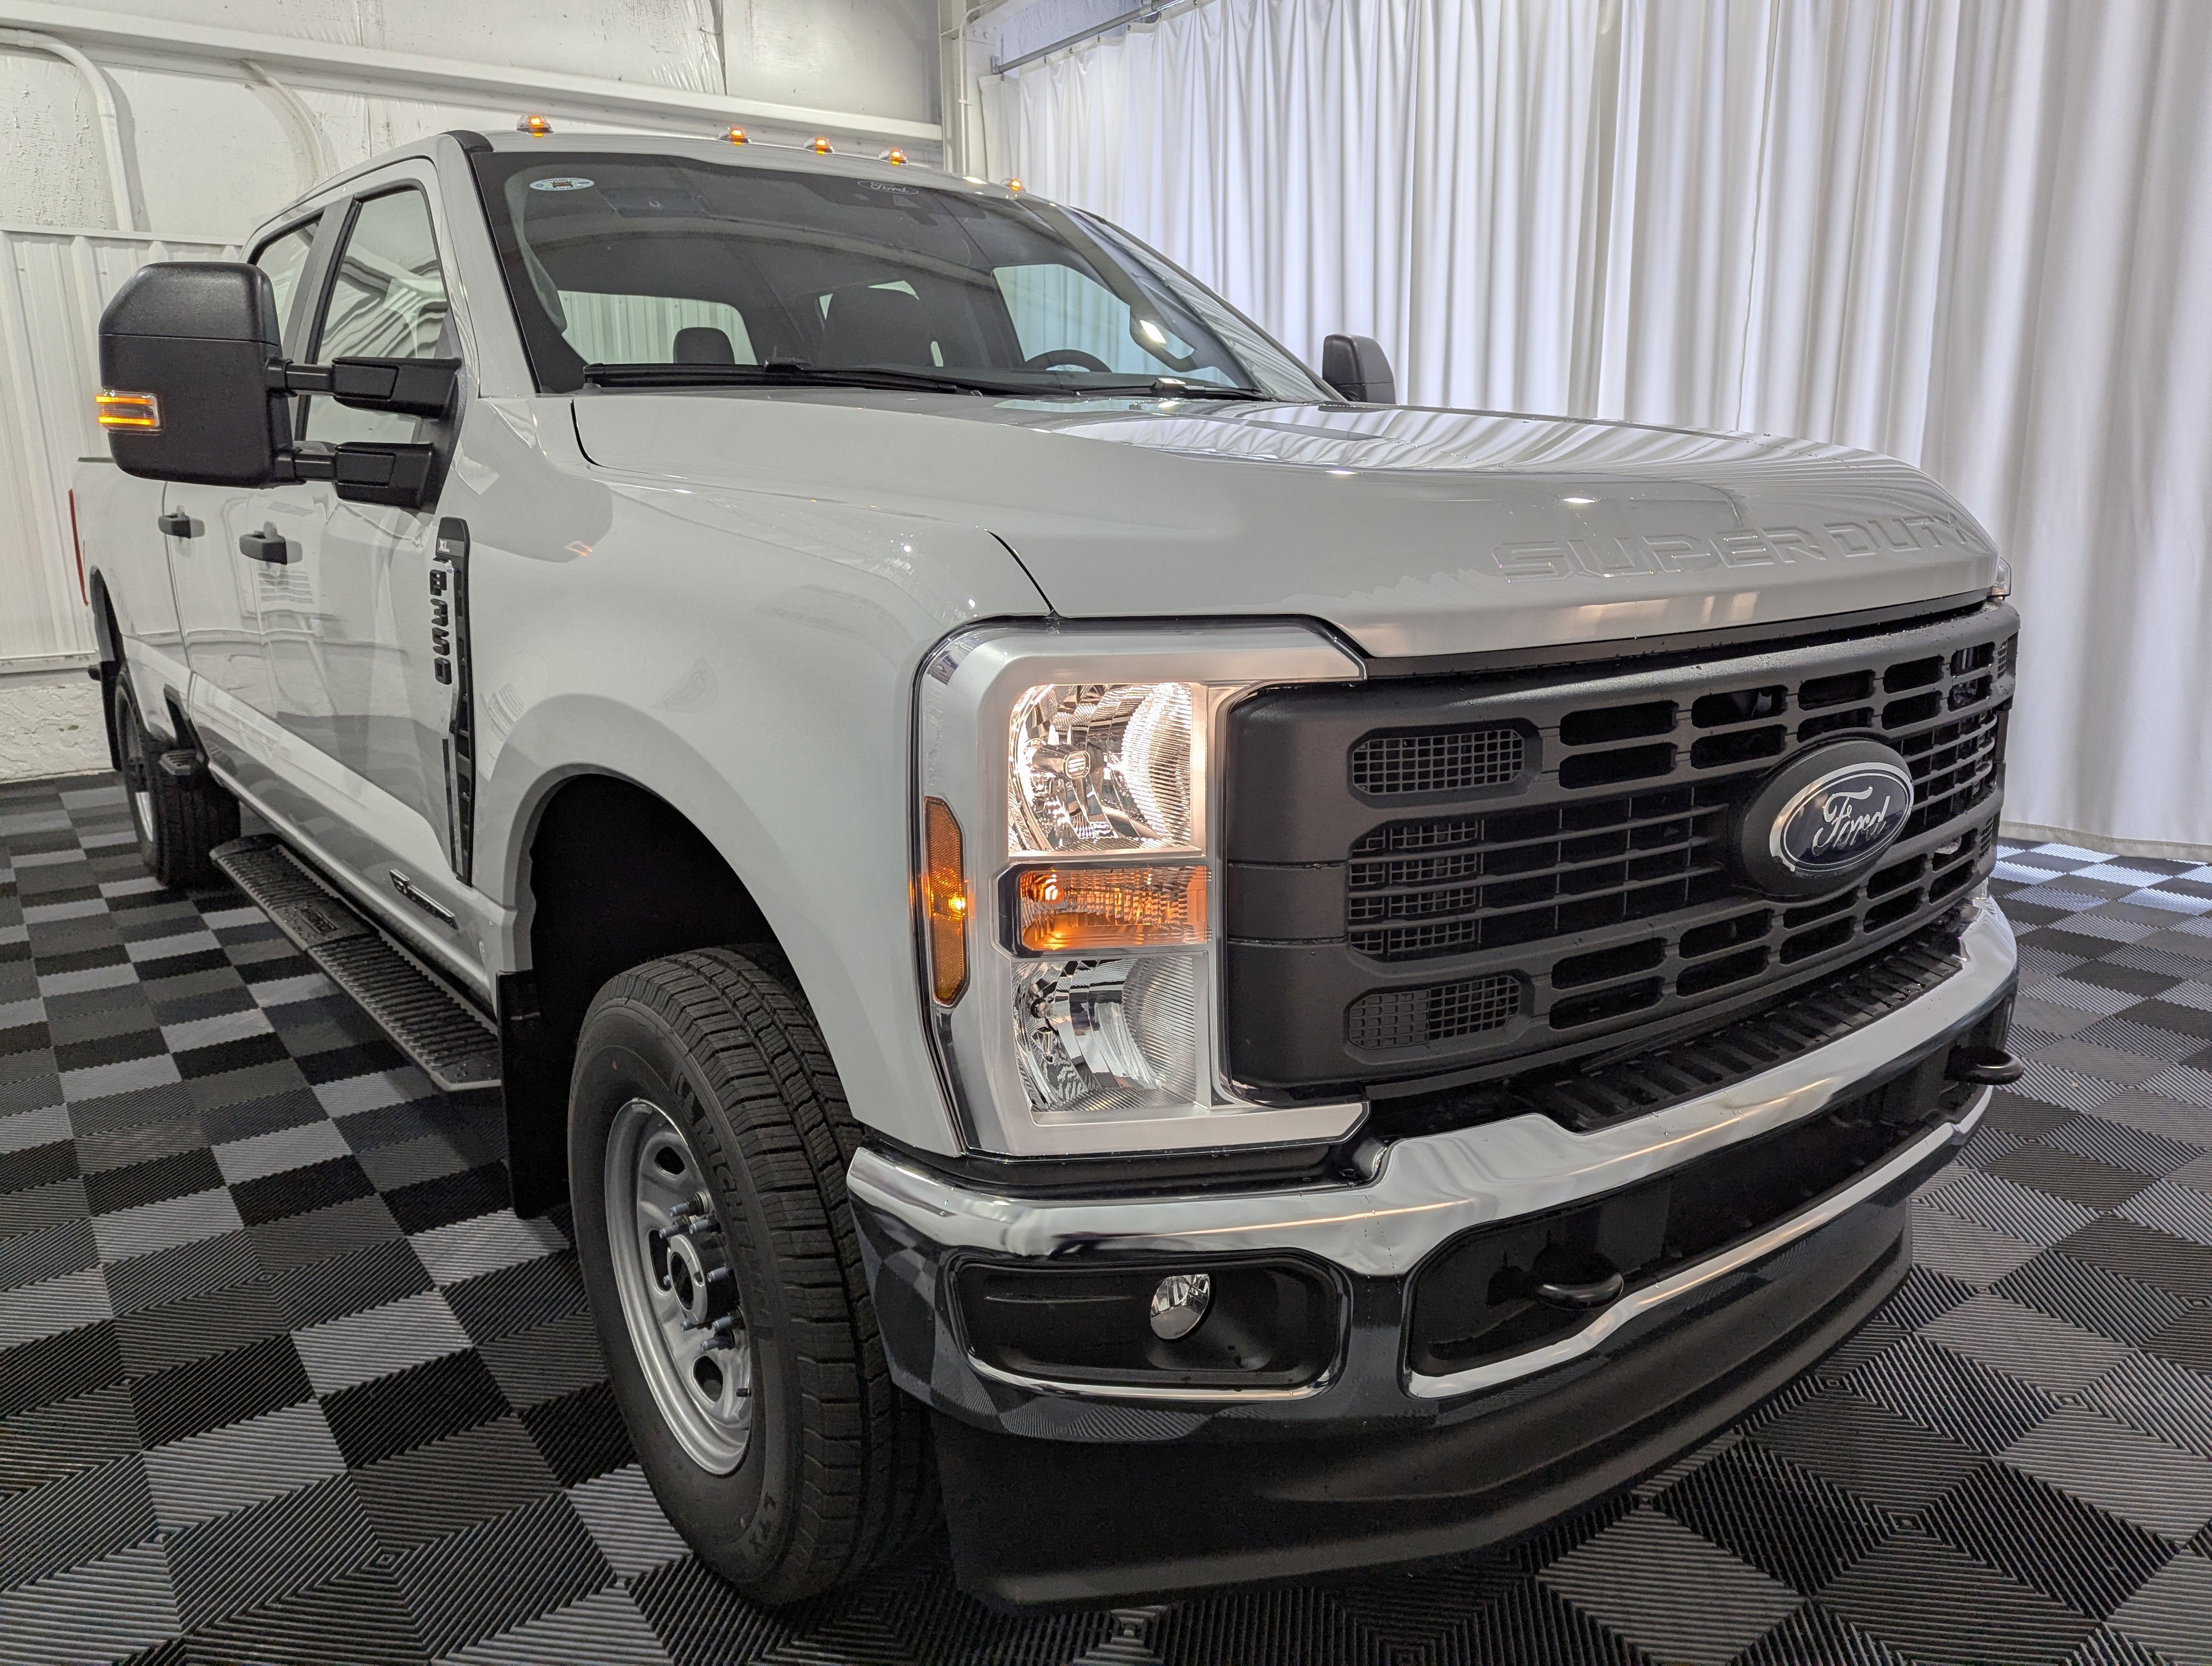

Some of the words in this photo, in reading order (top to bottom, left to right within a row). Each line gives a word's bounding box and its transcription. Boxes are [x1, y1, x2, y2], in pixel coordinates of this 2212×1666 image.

[870, 182, 909, 194] Ford
[438, 539, 451, 553] XL
[1490, 524, 1827, 584] SUPER
[1822, 512, 1969, 558] DUTY
[1811, 786, 1891, 856] Ford
